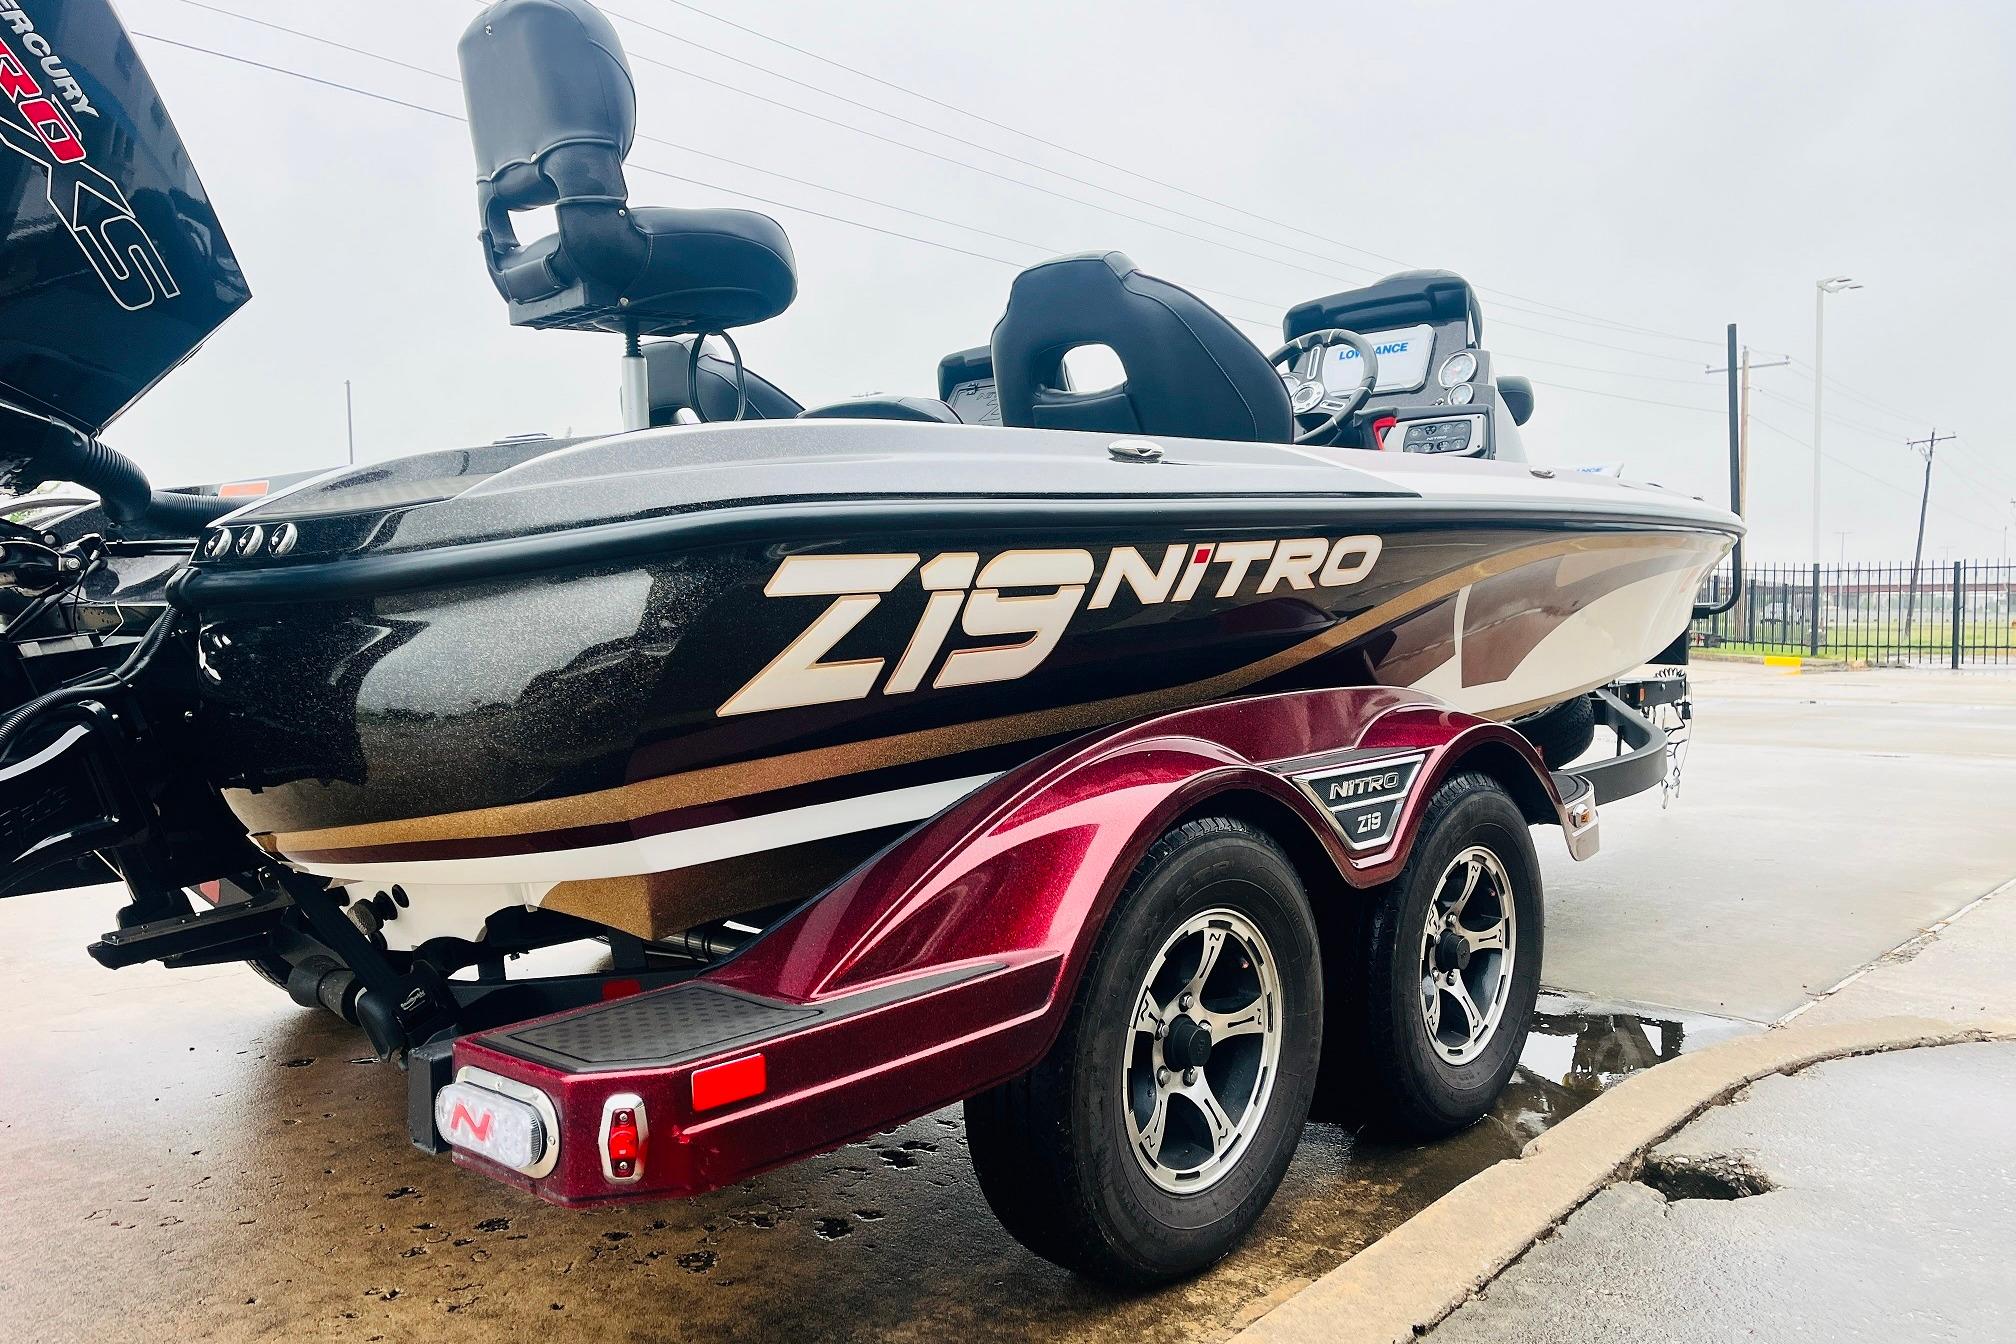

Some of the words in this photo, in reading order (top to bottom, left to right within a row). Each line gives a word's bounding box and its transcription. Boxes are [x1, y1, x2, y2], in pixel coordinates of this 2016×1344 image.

[1338, 341, 1409, 361] LOANCE
[716, 548, 1095, 718] Z19
[1087, 534, 1383, 610] NITRO
[1329, 771, 1399, 800] NITRO
[1356, 811, 1382, 835] Z19
[450, 1103, 491, 1142] N
